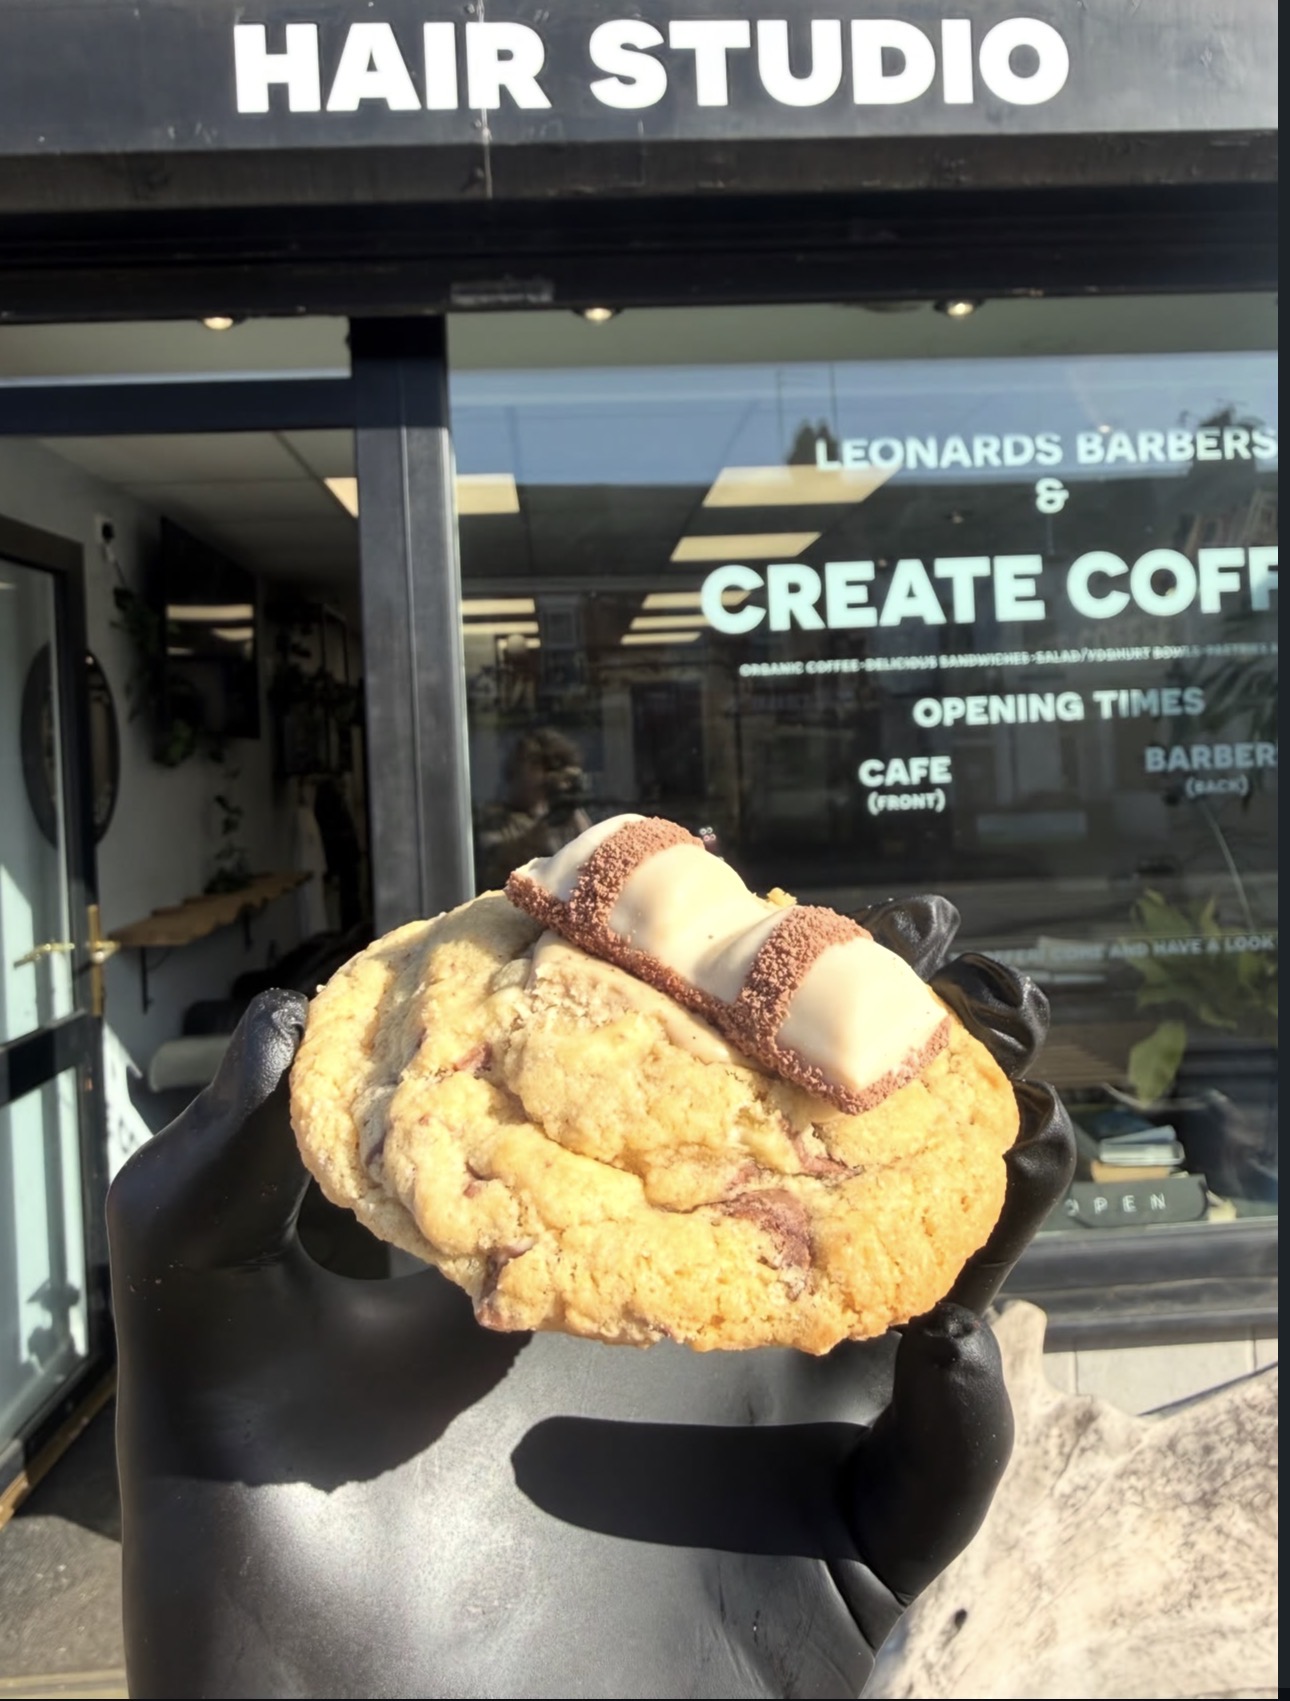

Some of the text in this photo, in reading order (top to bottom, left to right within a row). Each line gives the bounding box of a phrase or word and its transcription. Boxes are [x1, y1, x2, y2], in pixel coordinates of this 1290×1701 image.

[233, 16, 1070, 113] HAIR STUDIO
[815, 425, 1278, 471] LEONARDS BARBERS
[1035, 477, 1069, 514] &
[700, 554, 1046, 635] CREATE
[739, 660, 804, 677] ORGANIC
[912, 687, 1206, 728] OPENING TIMES
[858, 756, 952, 788] CAFE
[867, 787, 946, 816] (FRONT)
[1108, 941, 1150, 959] AND
[1153, 938, 1202, 956] HAVE
[1206, 937, 1221, 953] A
[1224, 935, 1275, 952] LOOK
